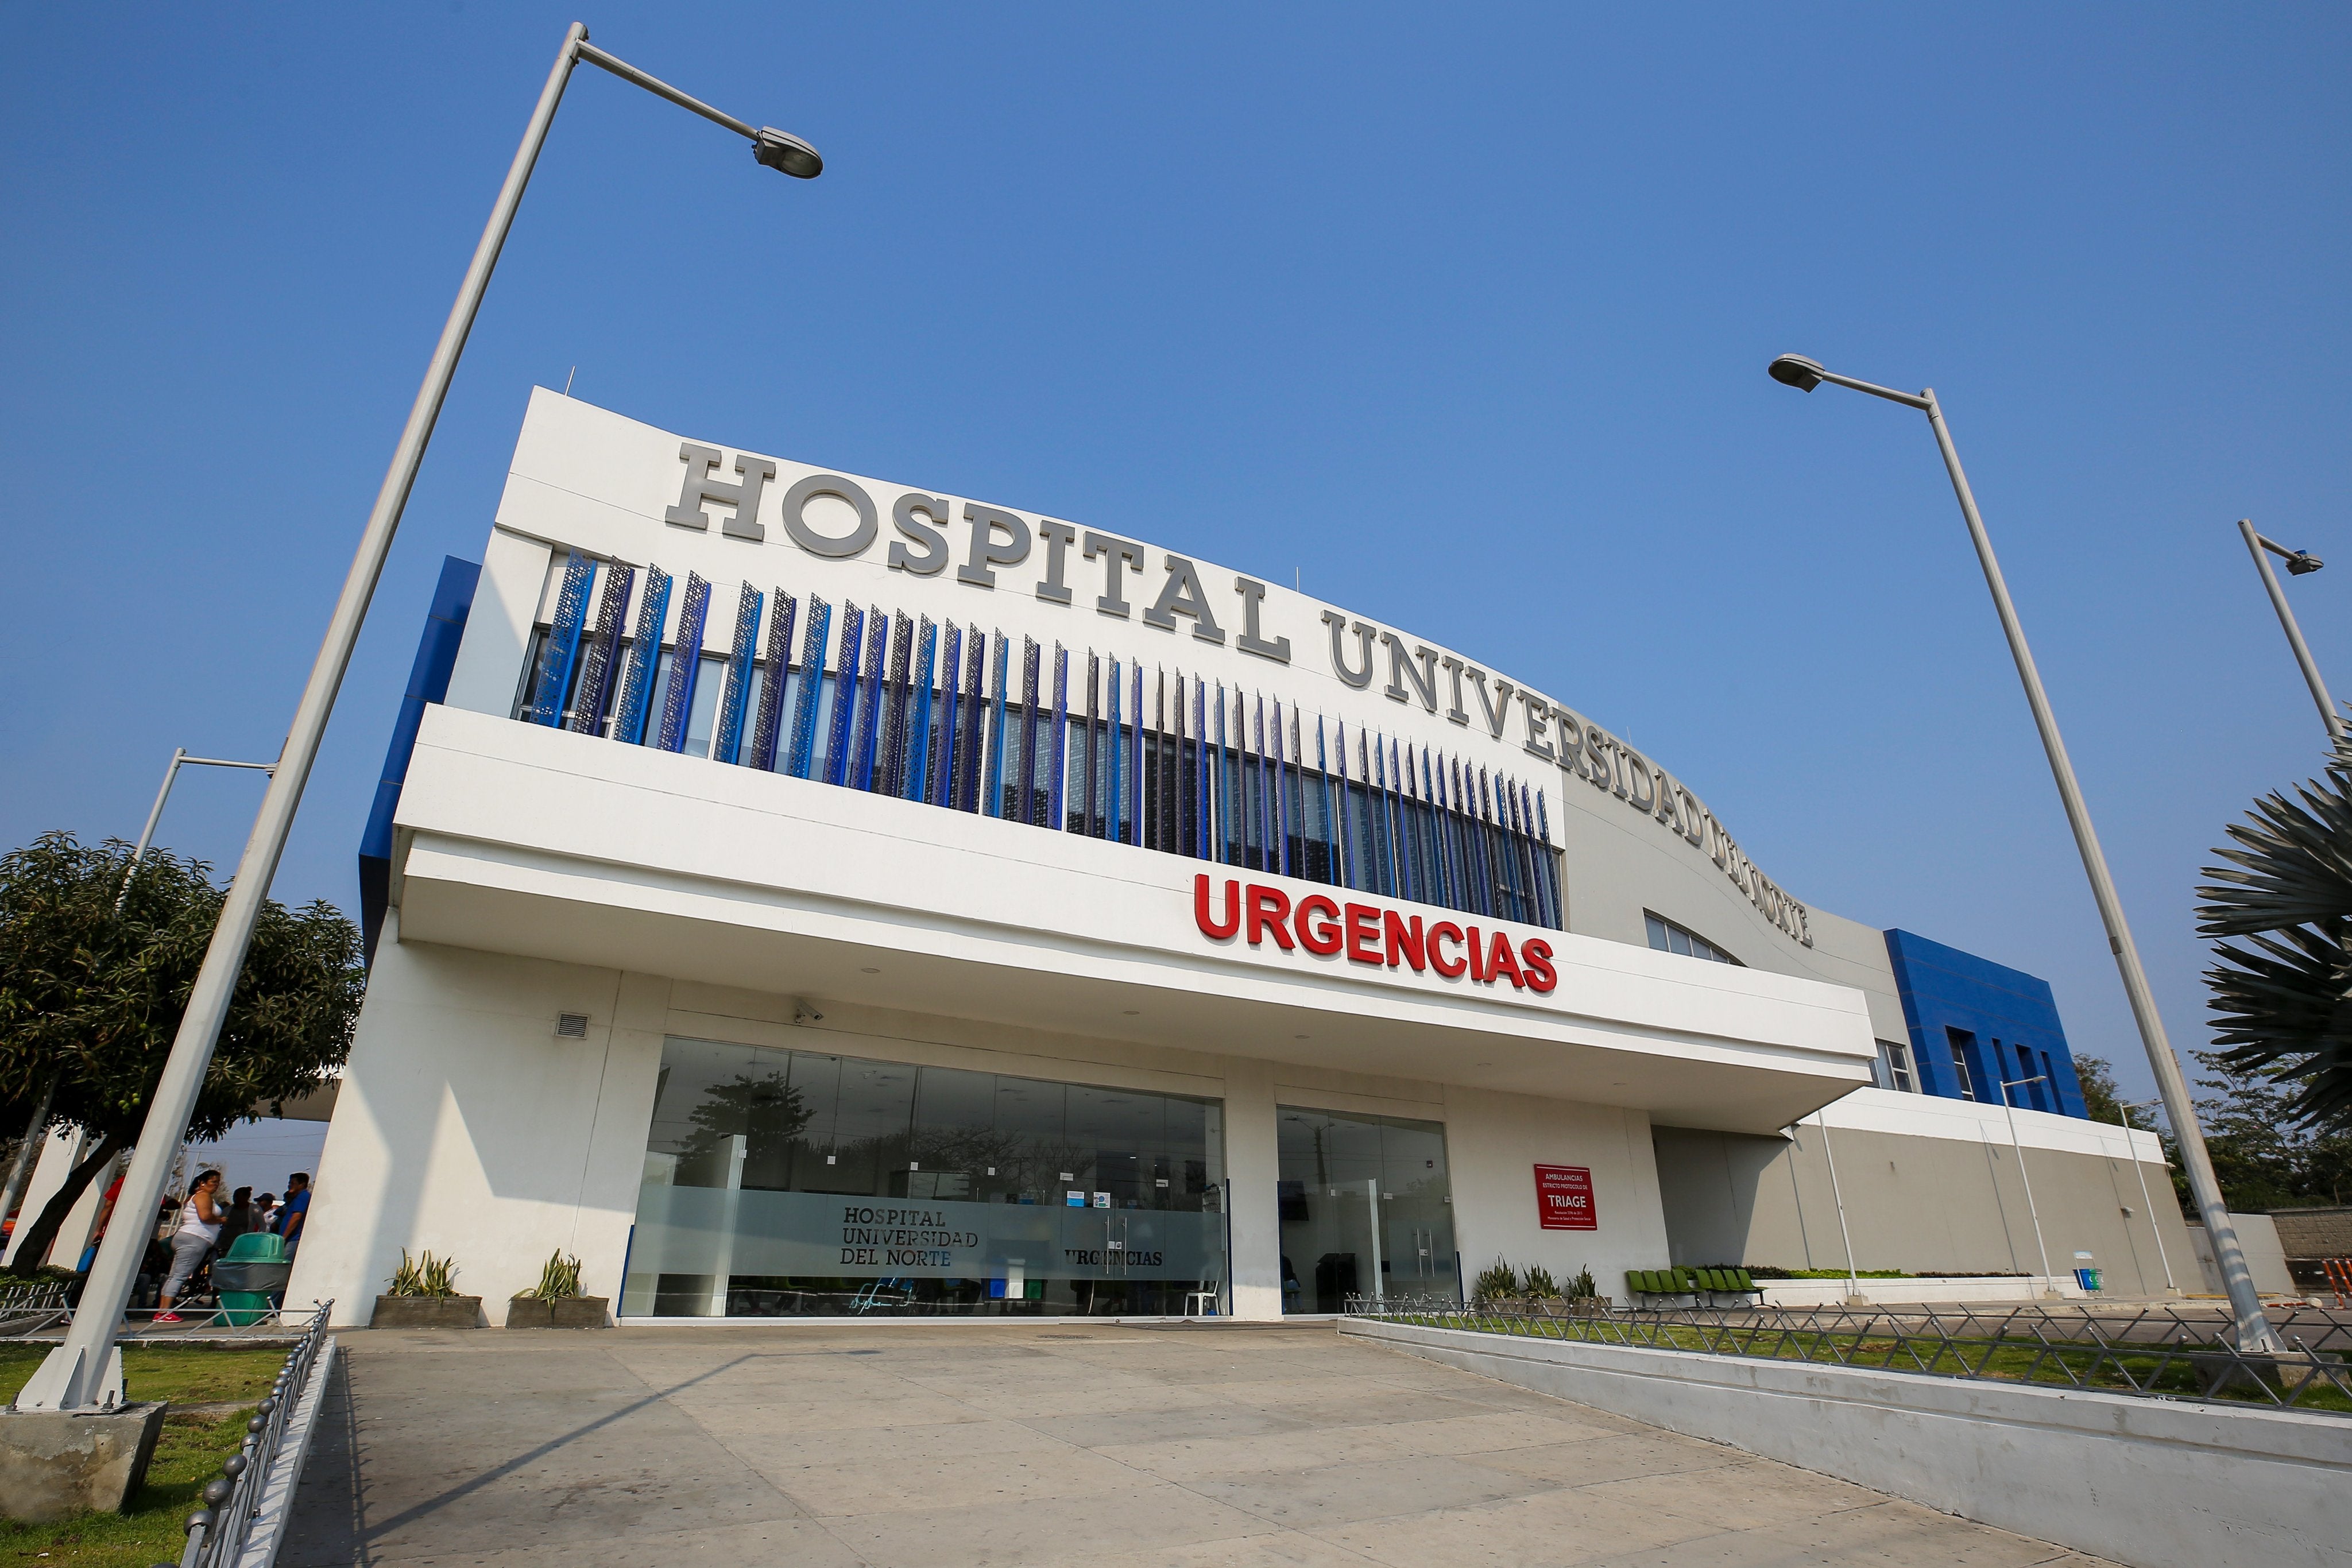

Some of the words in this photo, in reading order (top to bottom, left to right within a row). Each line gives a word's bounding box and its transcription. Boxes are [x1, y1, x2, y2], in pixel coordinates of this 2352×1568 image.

[665, 442, 1291, 664] HOSPITAL
[1321, 610, 1704, 846] UNIVERSIDAD
[1703, 808, 1750, 894] DEL
[1742, 857, 1814, 948] NORTE
[1194, 873, 1557, 993] URGENCIAS
[1546, 1174, 1583, 1182] AMBULANCIAS
[1548, 1195, 1587, 1207] TRIAGE
[844, 1207, 946, 1227] HOSPITAL
[843, 1228, 978, 1248] UNIVERSIDAD
[840, 1248, 878, 1265] DEL
[885, 1249, 951, 1267] NORTE
[1065, 1249, 1163, 1267] URGENCIAS
